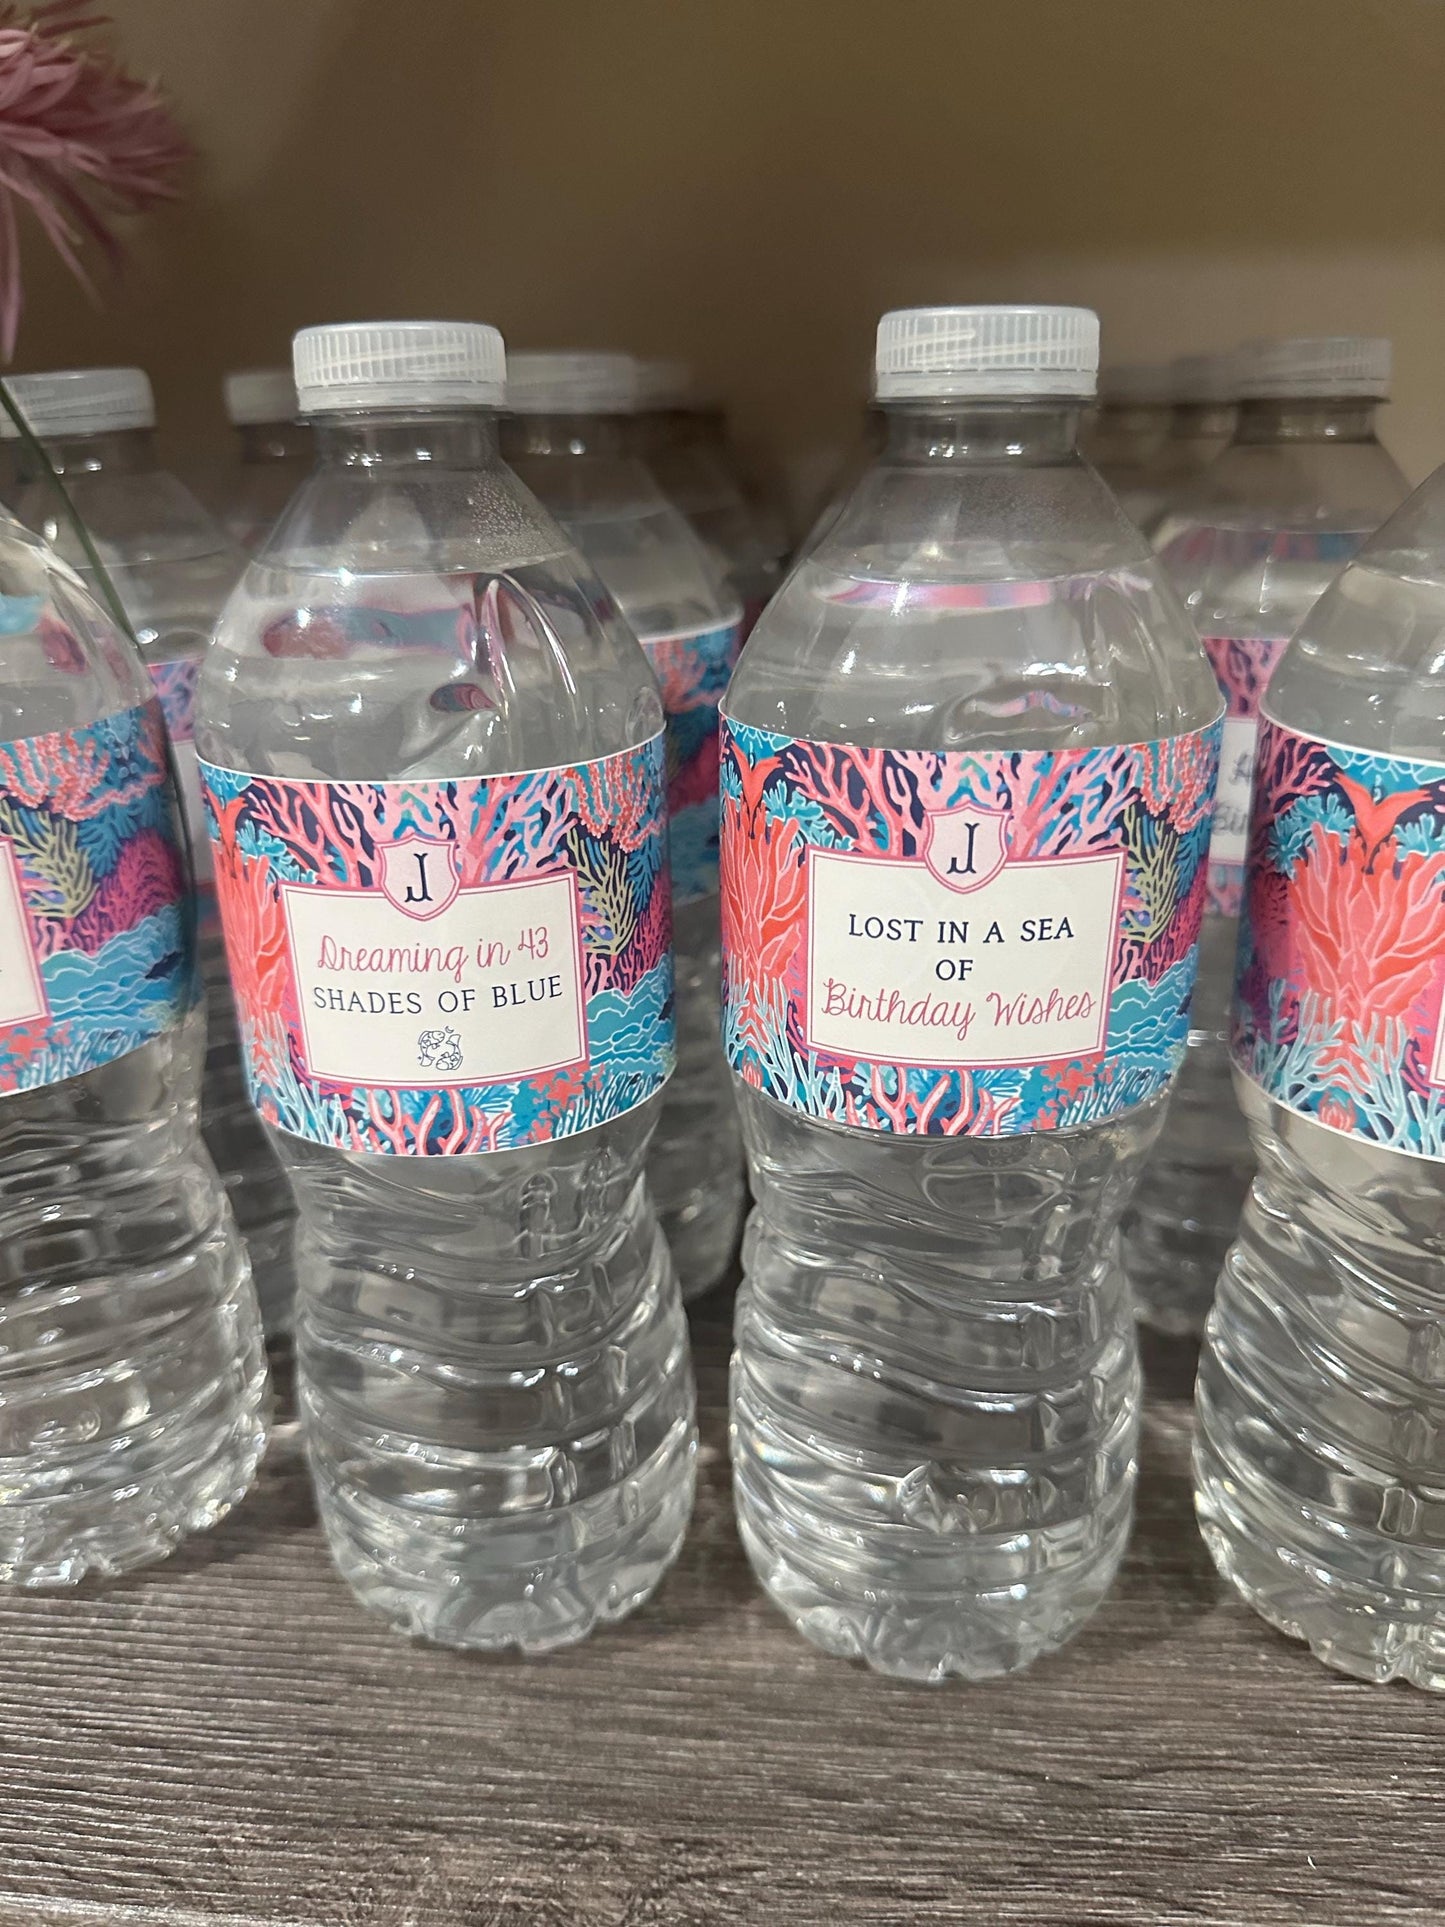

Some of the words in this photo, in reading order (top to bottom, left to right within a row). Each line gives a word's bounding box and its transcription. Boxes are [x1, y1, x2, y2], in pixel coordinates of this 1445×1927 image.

[848, 913, 924, 943] LOST
[937, 921, 969, 944] IN
[983, 921, 1005, 944] A
[1019, 916, 1075, 942] SEA
[316, 934, 470, 983] Dreaming
[476, 937, 511, 968] in
[517, 926, 549, 961] 43
[935, 959, 974, 981] OF
[312, 986, 423, 1014] SHADES
[437, 989, 476, 1013] OF
[491, 974, 563, 1009] BLUE
[820, 977, 976, 1041] Birthday
[985, 987, 1097, 1027] Wishes
